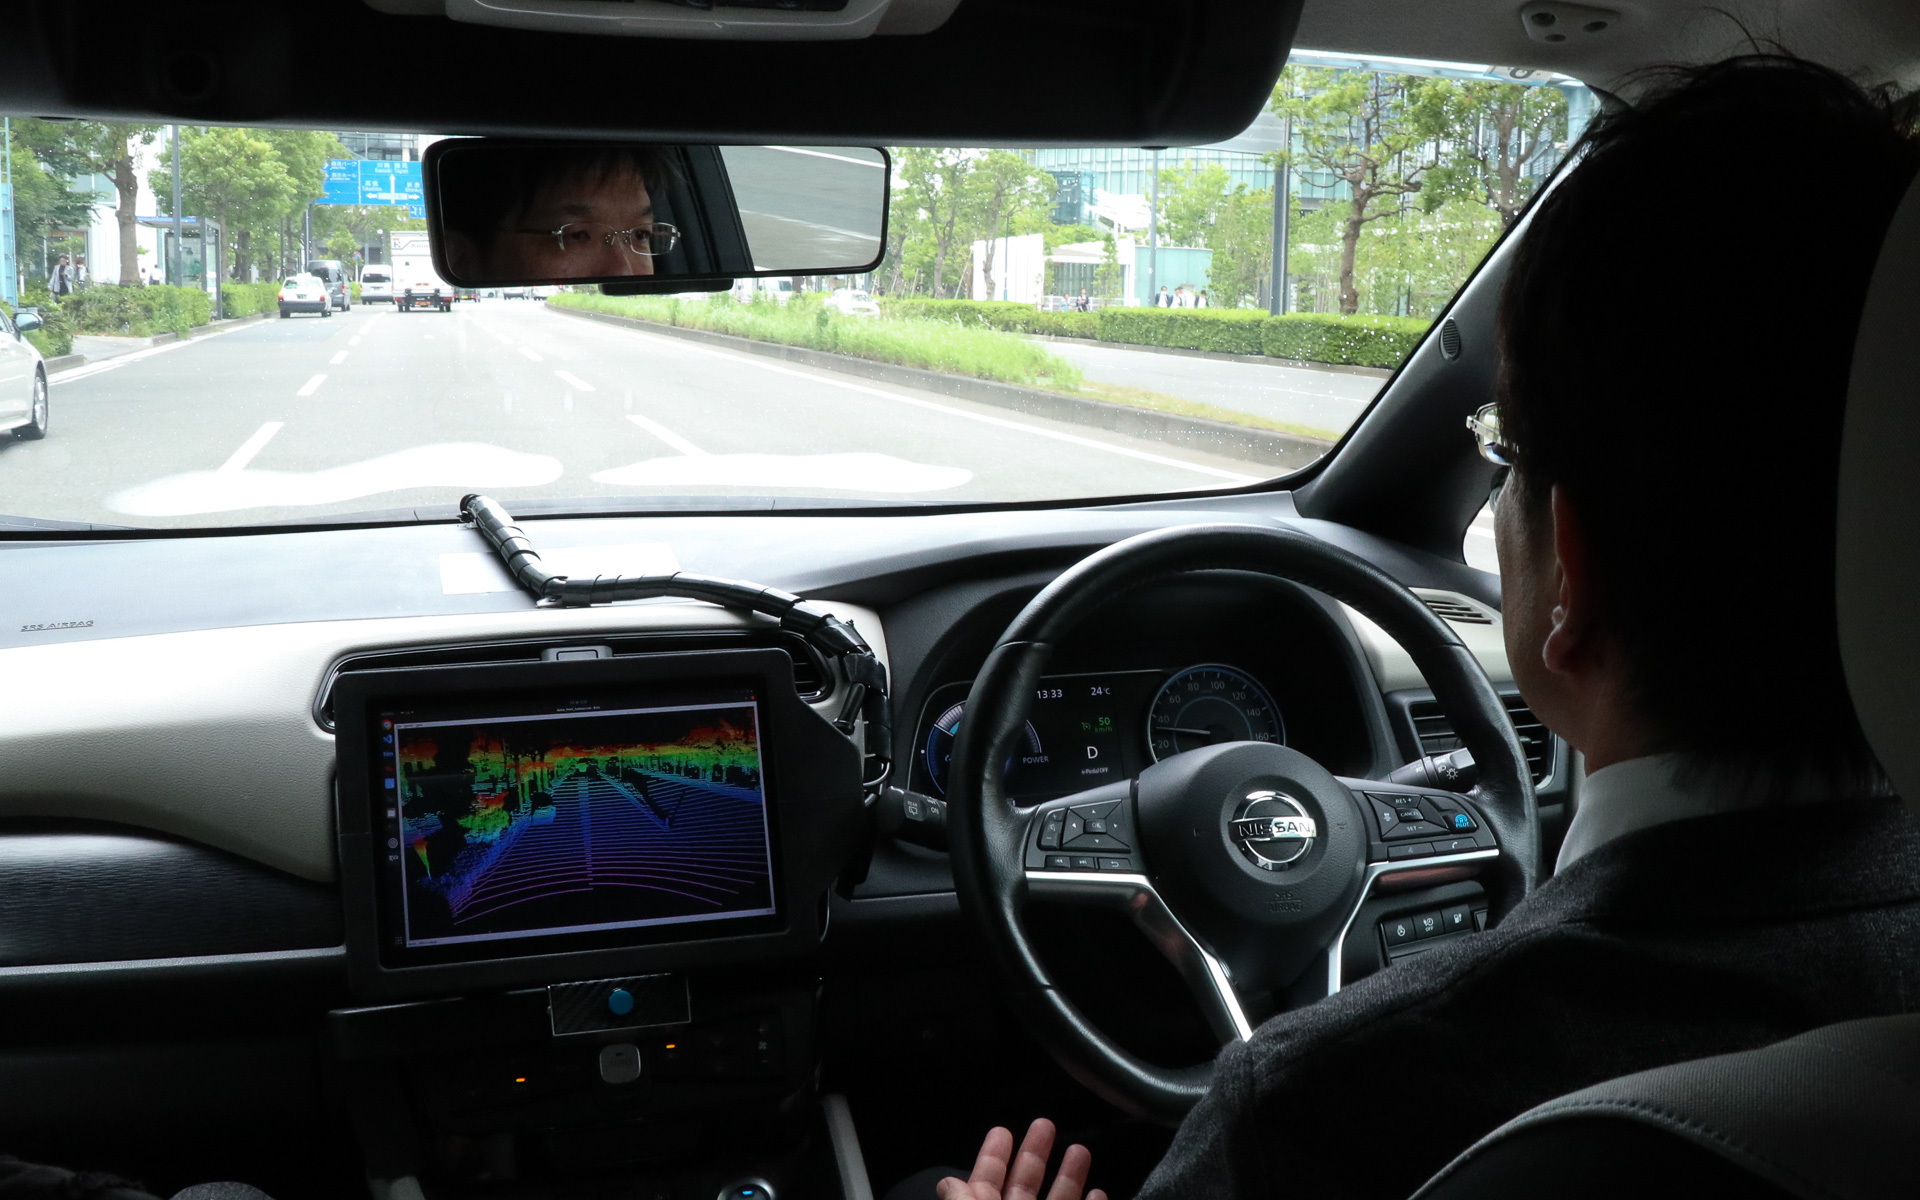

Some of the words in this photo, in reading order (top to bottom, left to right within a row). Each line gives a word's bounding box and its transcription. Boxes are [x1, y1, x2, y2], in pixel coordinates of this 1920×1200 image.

[46, 620, 94, 630] AIRBAG
[1188, 682, 1200, 692] 80
[1210, 681, 1225, 690] 100
[1036, 689, 1063, 700] 13:33
[1232, 692, 1246, 701] 120
[1169, 695, 1181, 704] 60
[1247, 708, 1261, 717] 140
[1098, 717, 1111, 726] 50
[1158, 715, 1170, 724] 40
[1255, 732, 1270, 742] 160
[1158, 740, 1170, 749] 20
[1086, 746, 1099, 759] D
[1022, 756, 1049, 764] POWER
[1238, 821, 1311, 837] NISSAN
